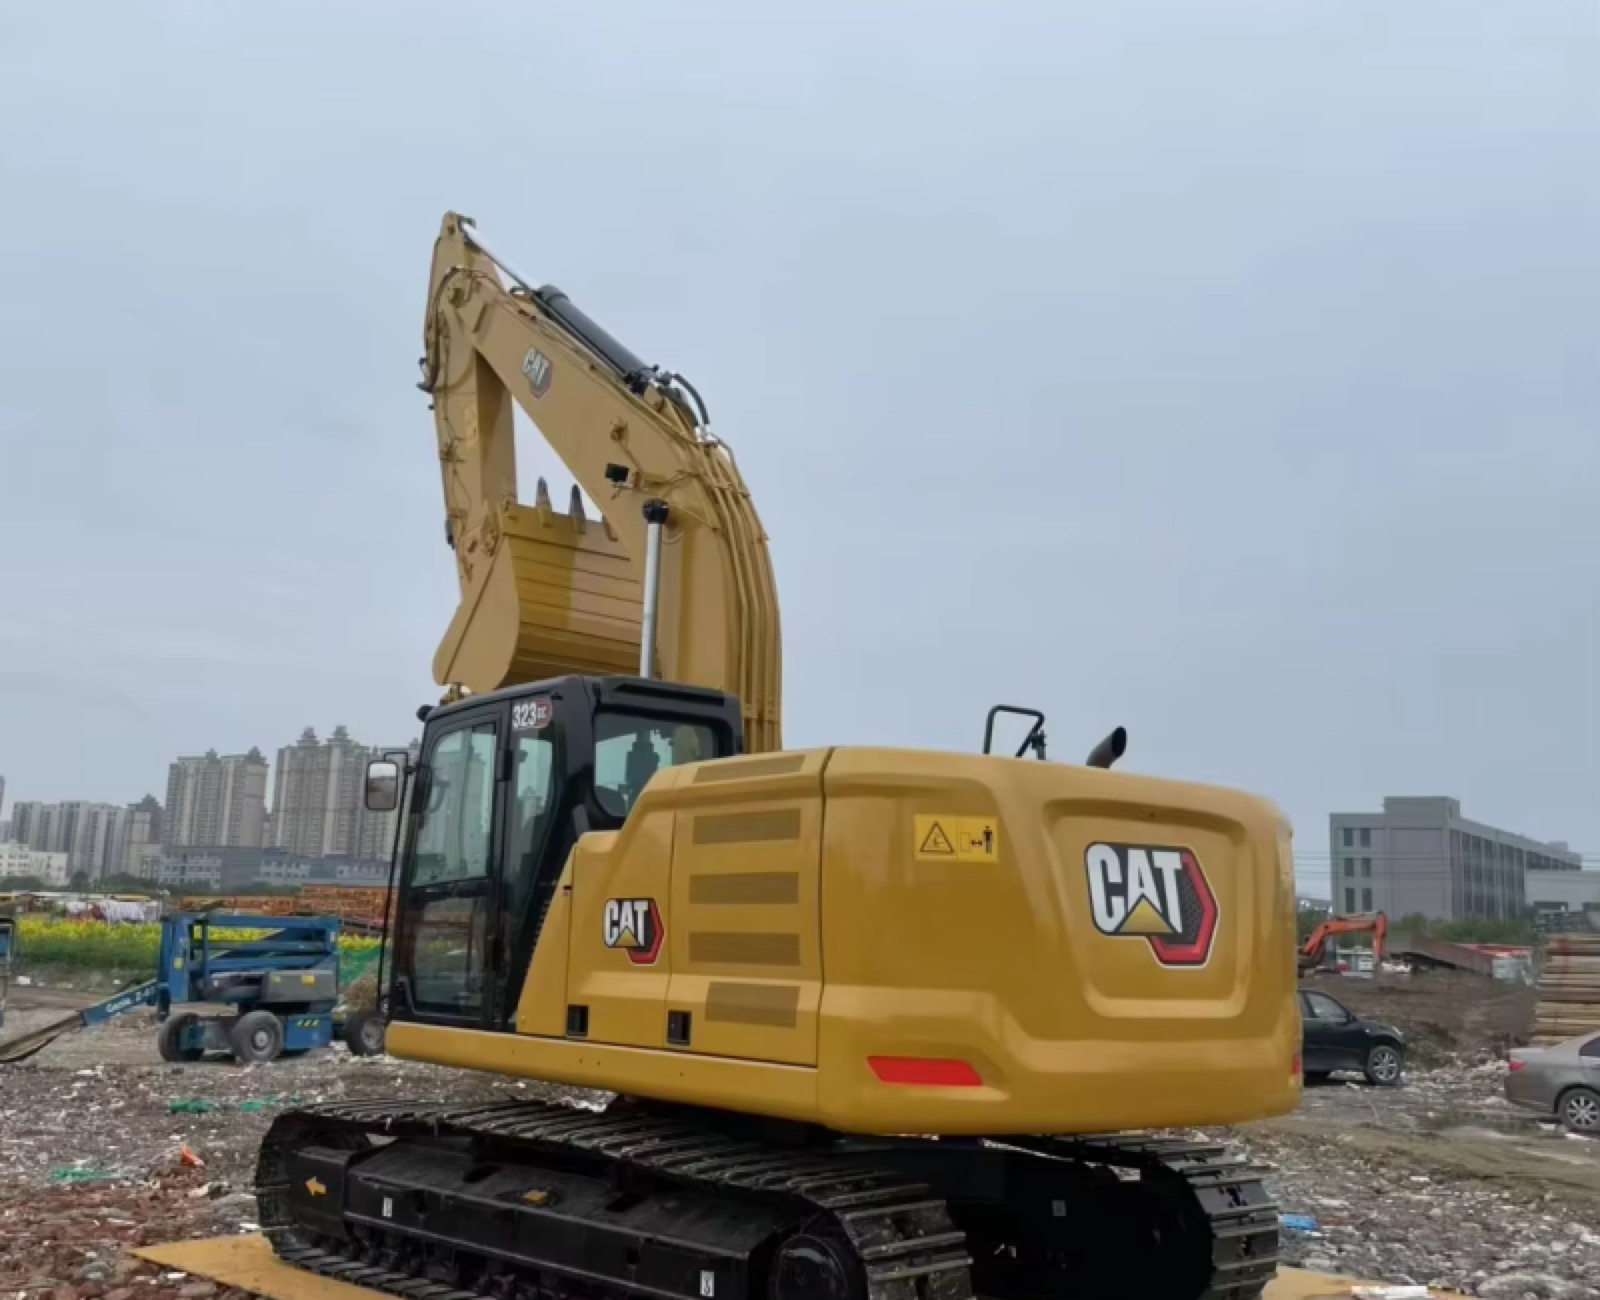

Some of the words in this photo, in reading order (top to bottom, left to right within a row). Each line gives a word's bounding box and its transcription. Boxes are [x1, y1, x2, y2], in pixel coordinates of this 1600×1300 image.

[522, 347, 549, 386] CAT
[512, 702, 537, 728] 323
[1087, 843, 1183, 933] CAT
[605, 899, 649, 947] CAT
